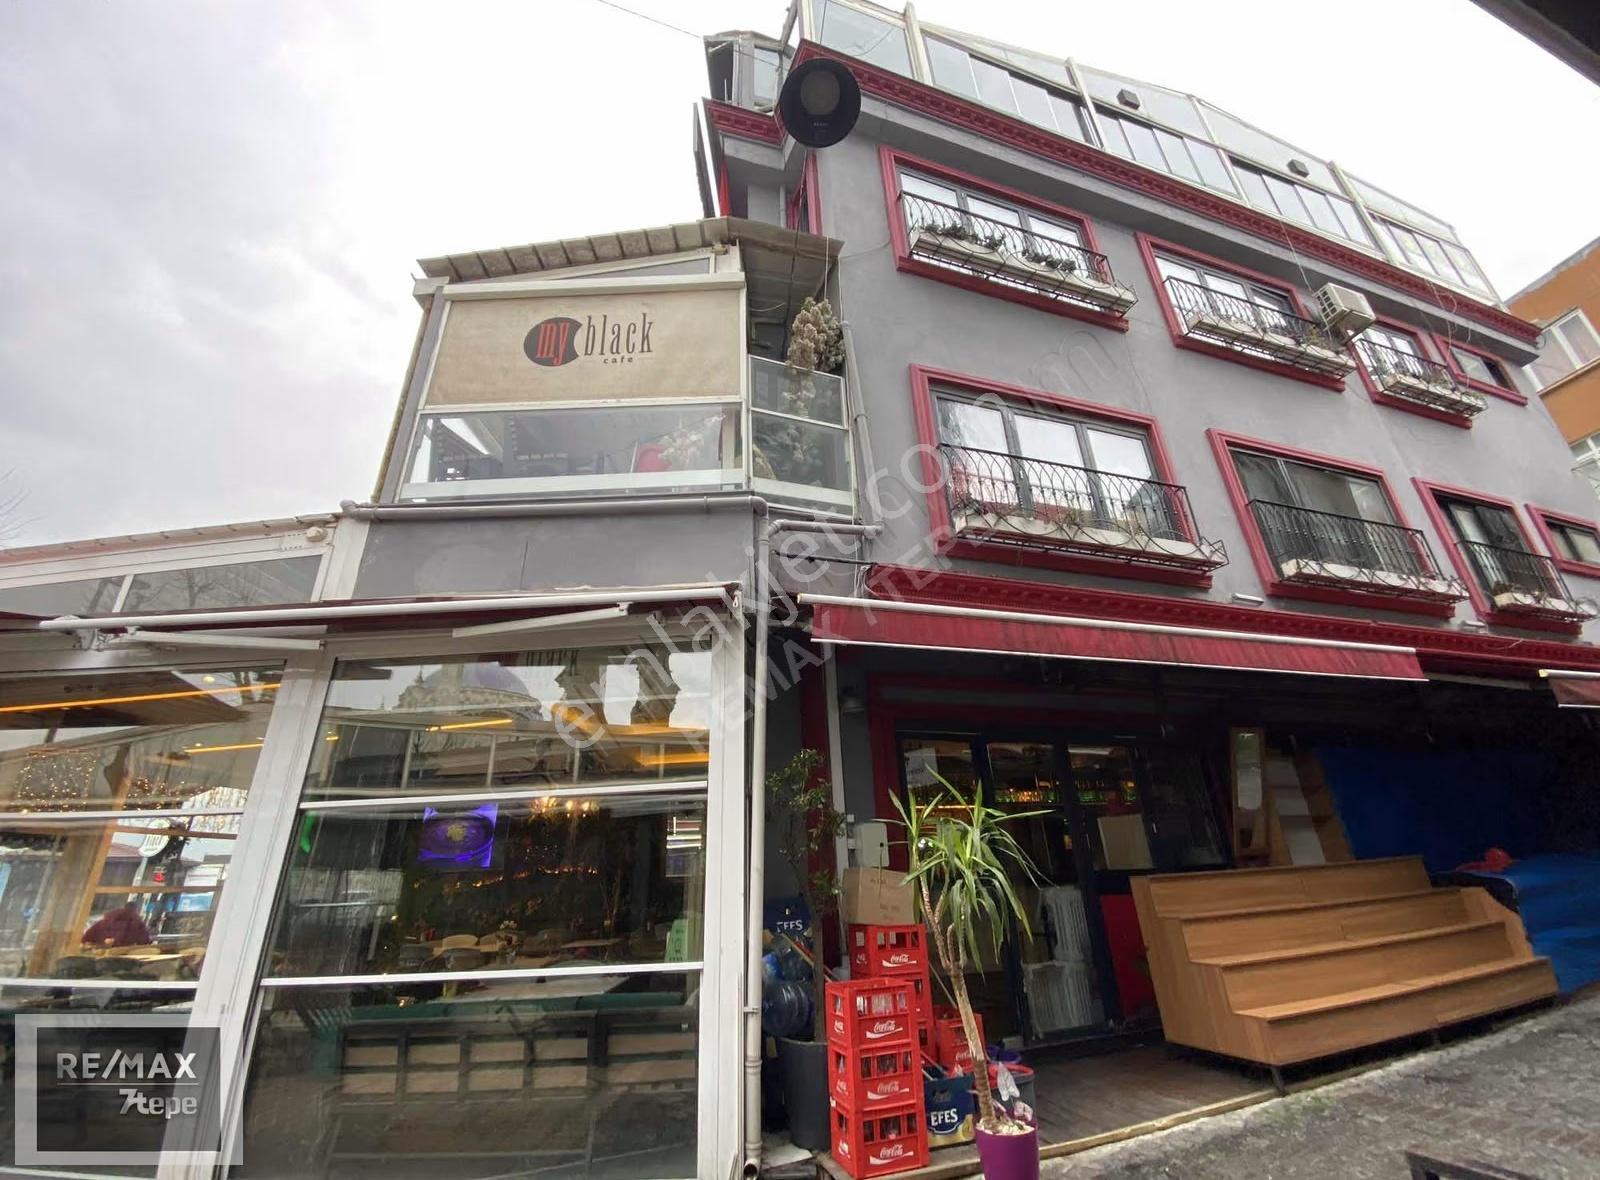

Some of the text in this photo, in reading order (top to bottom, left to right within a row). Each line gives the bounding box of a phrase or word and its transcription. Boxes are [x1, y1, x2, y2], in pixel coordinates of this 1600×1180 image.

[535, 312, 653, 366] my black
[603, 355, 634, 365] cafe
[930, 1108, 959, 1127] EFES
